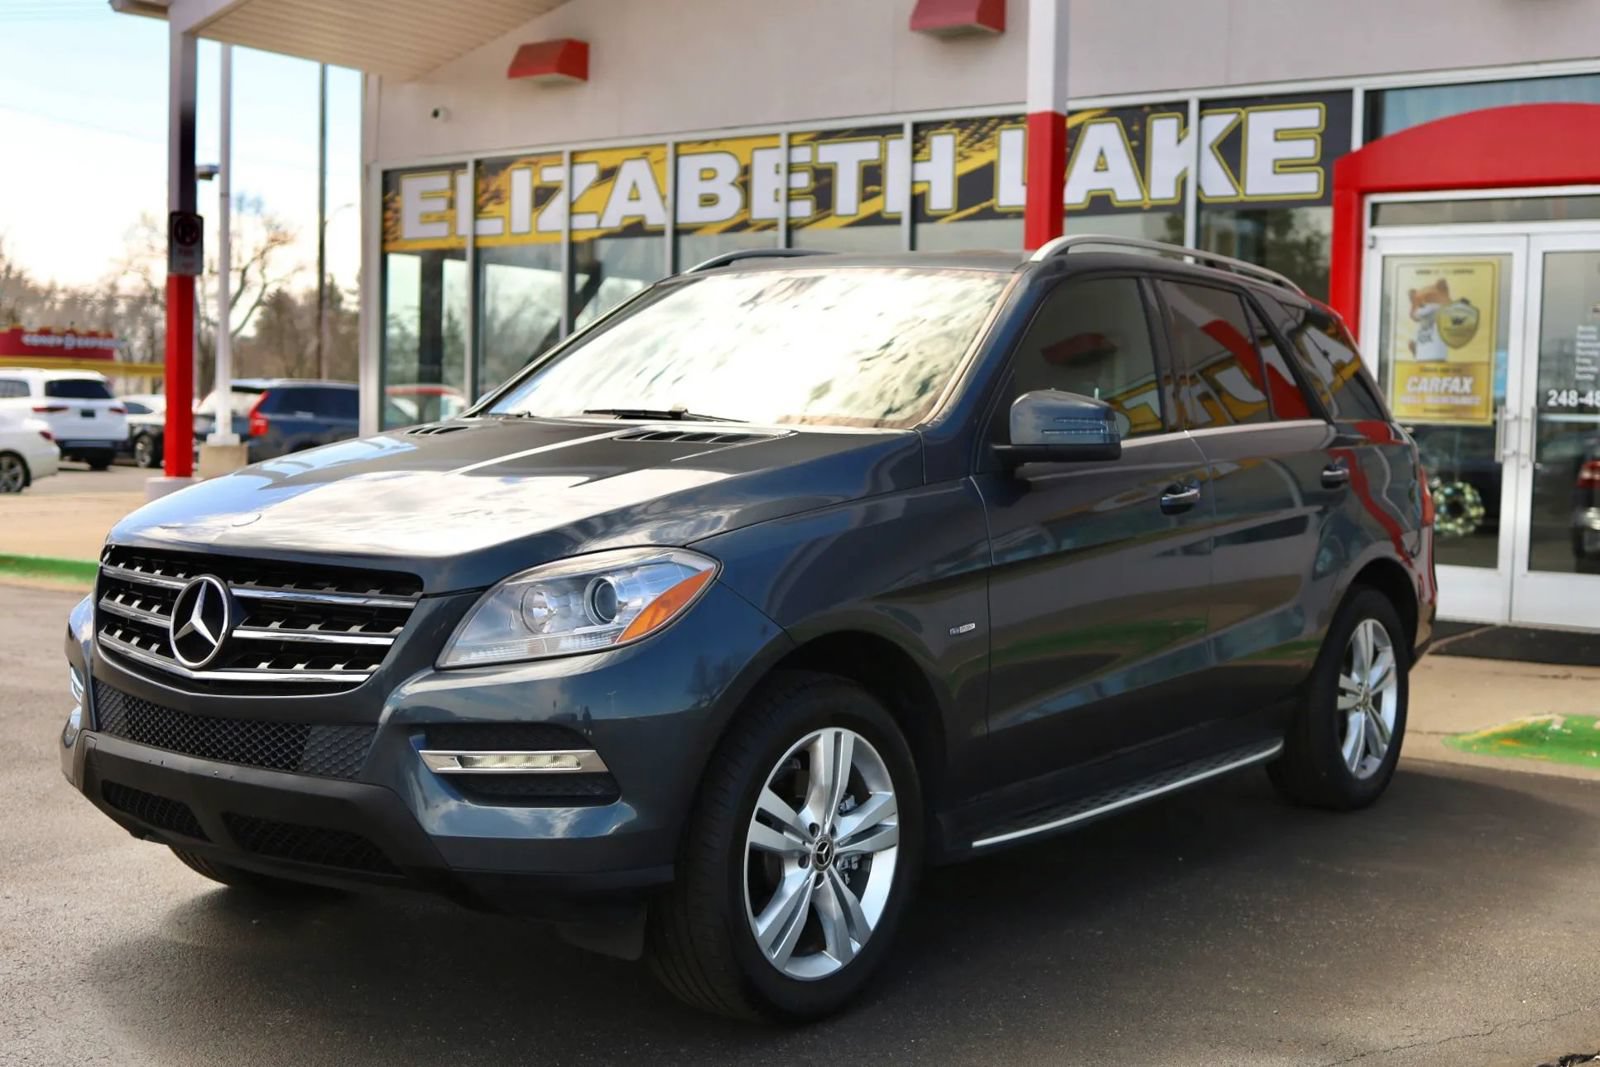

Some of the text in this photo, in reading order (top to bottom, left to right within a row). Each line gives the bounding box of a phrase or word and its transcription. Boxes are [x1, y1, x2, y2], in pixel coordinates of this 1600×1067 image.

[400, 102, 1325, 241] ELIZABETH LAKE
[1407, 376, 1474, 395] CARFAX
